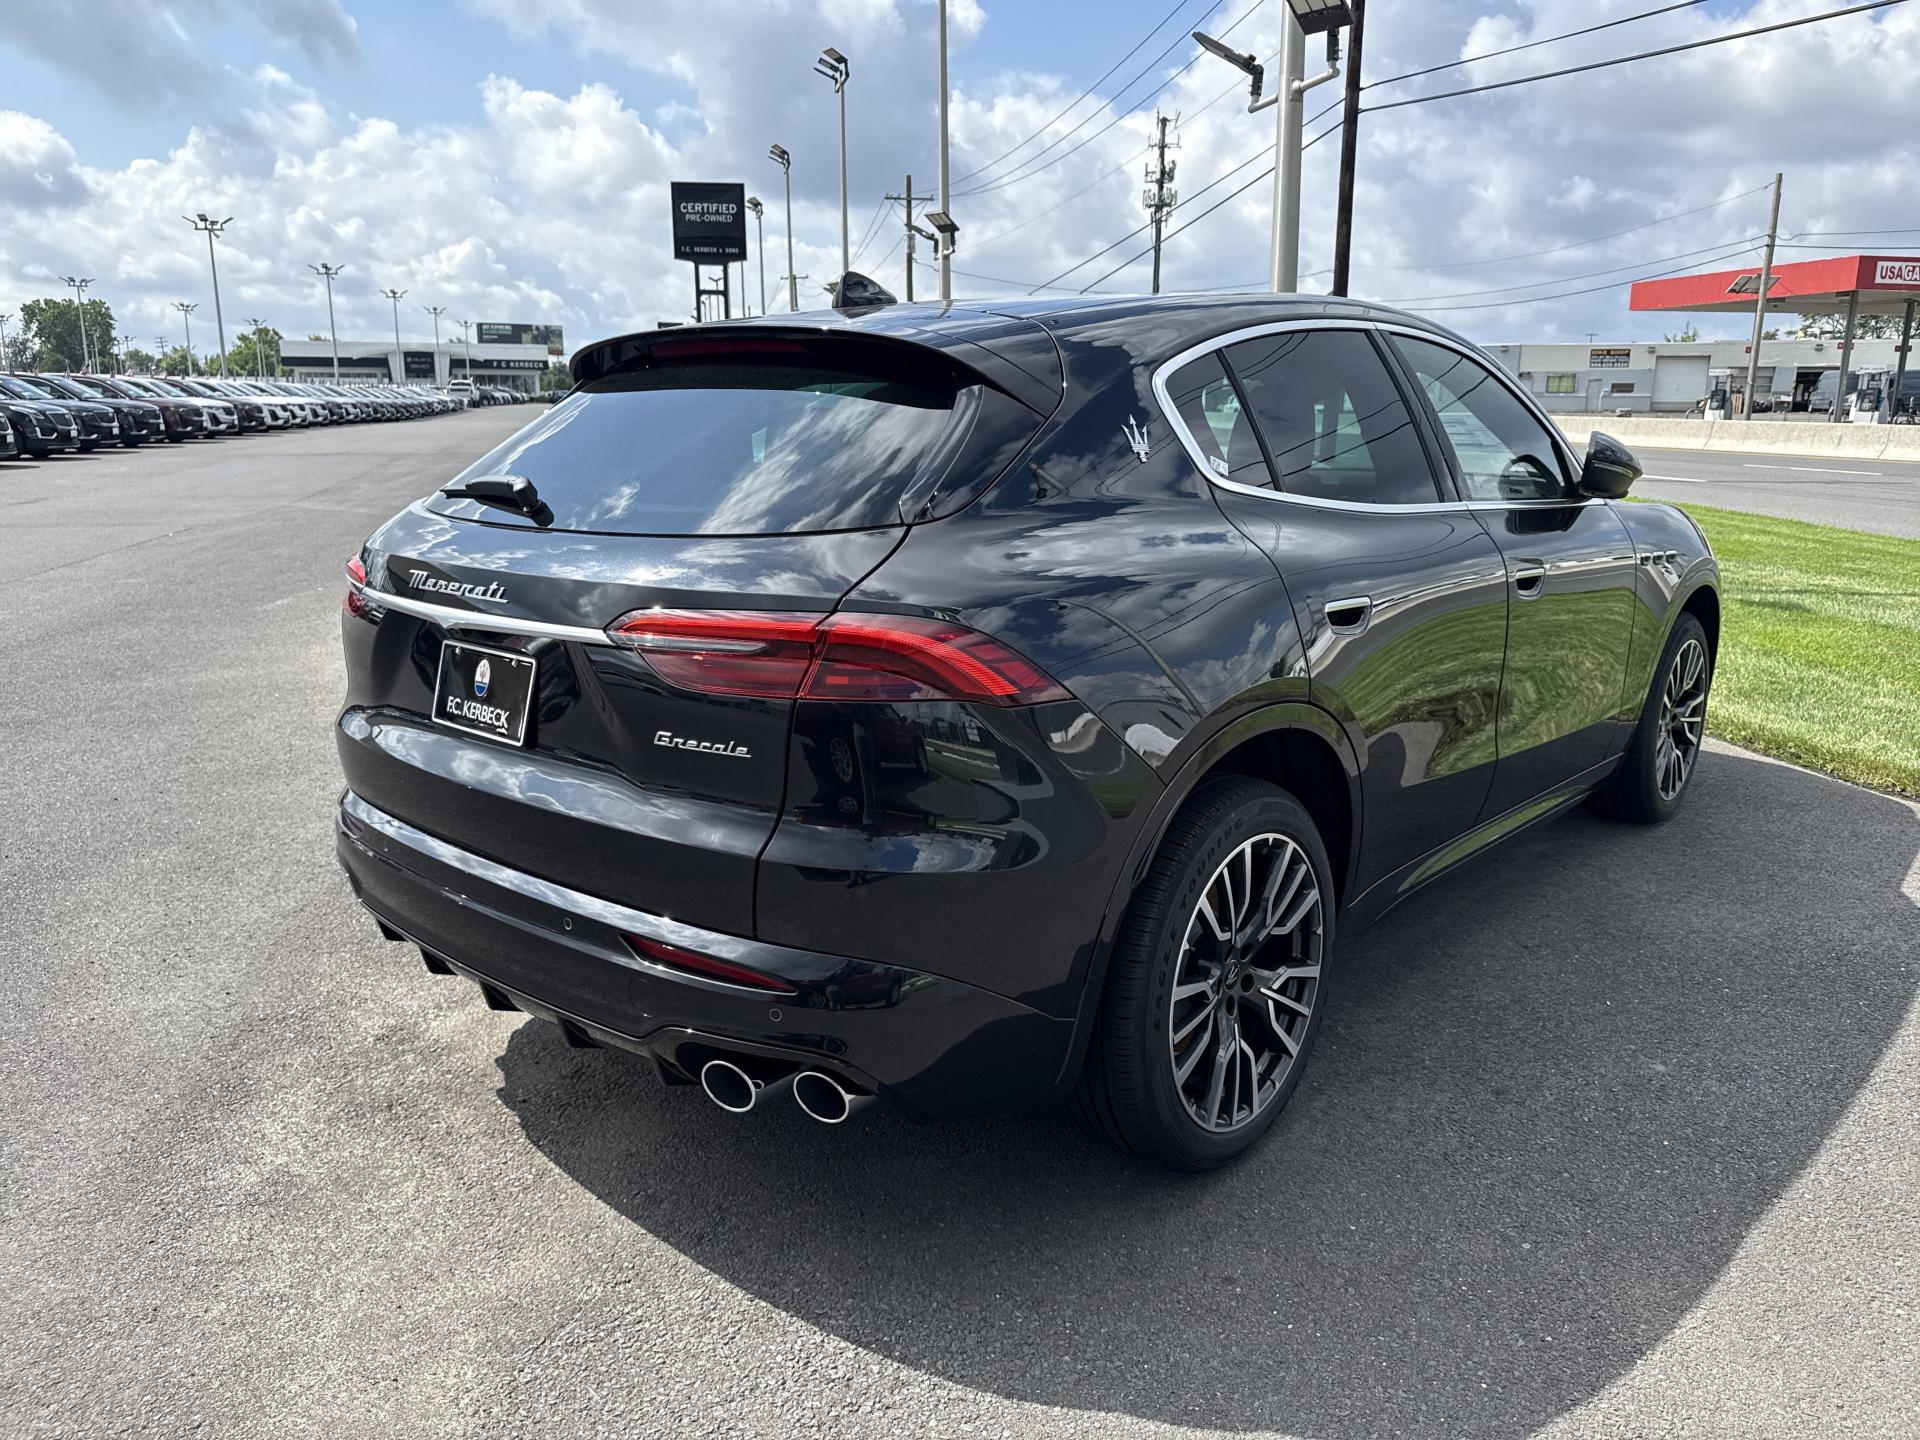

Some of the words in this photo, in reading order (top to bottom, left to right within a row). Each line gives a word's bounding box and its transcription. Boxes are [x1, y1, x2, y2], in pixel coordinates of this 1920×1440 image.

[680, 202, 737, 214] CERTIFIED
[685, 214, 733, 223] PRE-OWNED
[510, 361, 544, 369] KERBECK
[409, 569, 510, 604] Maserati
[462, 699, 510, 729] KERBECK
[653, 730, 752, 758] Grecale
[1153, 925, 1178, 1031] EAGLE
[1179, 817, 1244, 911] TOURING
